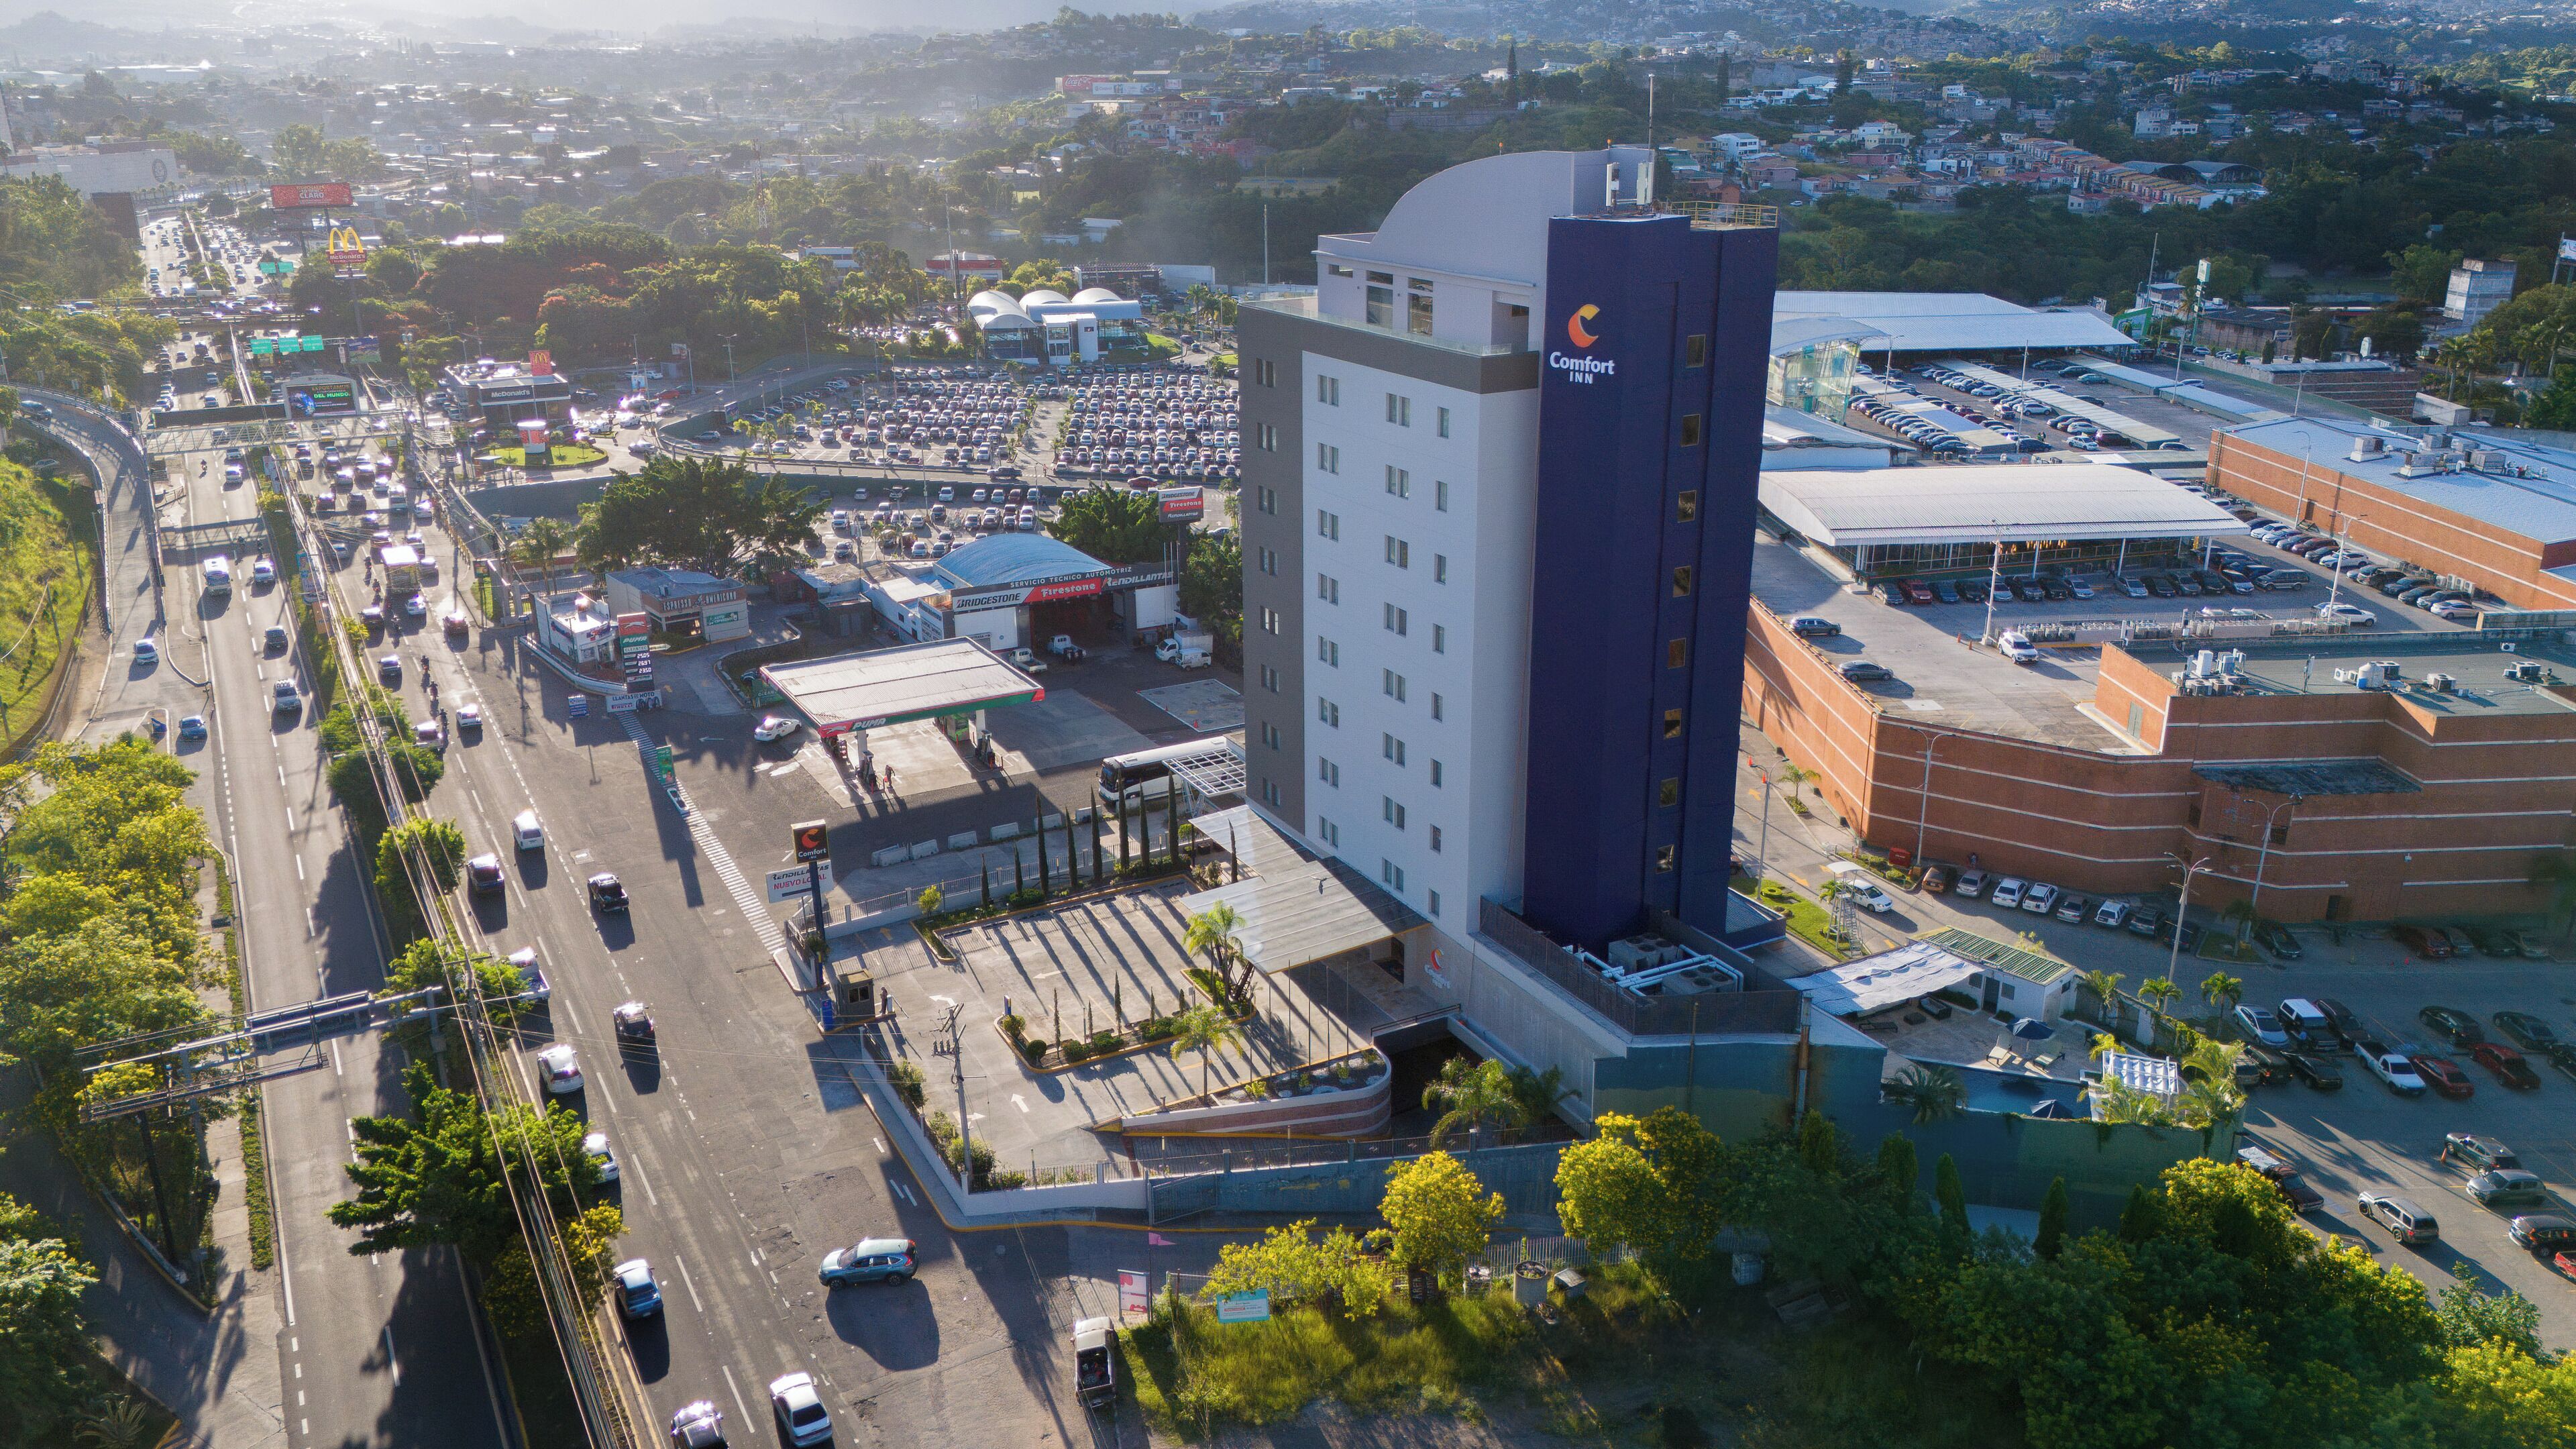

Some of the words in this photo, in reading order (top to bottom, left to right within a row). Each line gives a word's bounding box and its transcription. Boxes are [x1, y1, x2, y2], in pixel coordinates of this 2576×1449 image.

[1550, 352, 1615, 374] Comfort
[1569, 371, 1593, 384] INN
[491, 389, 530, 398] McDonald's
[1010, 579, 1045, 588] SERVICIO
[1050, 574, 1081, 584] TECNICO
[1085, 567, 1132, 578] AUTOMOTRIZ
[1040, 582, 1095, 597] Firestone
[663, 598, 692, 611] ESPRESSO
[706, 591, 737, 604] AMERICANO
[956, 592, 1021, 608] BRIDGESTONE
[853, 718, 886, 730] PUMA
[798, 848, 827, 857] Comfort
[773, 879, 801, 890] NUEVO
[802, 873, 826, 883] LOAL
